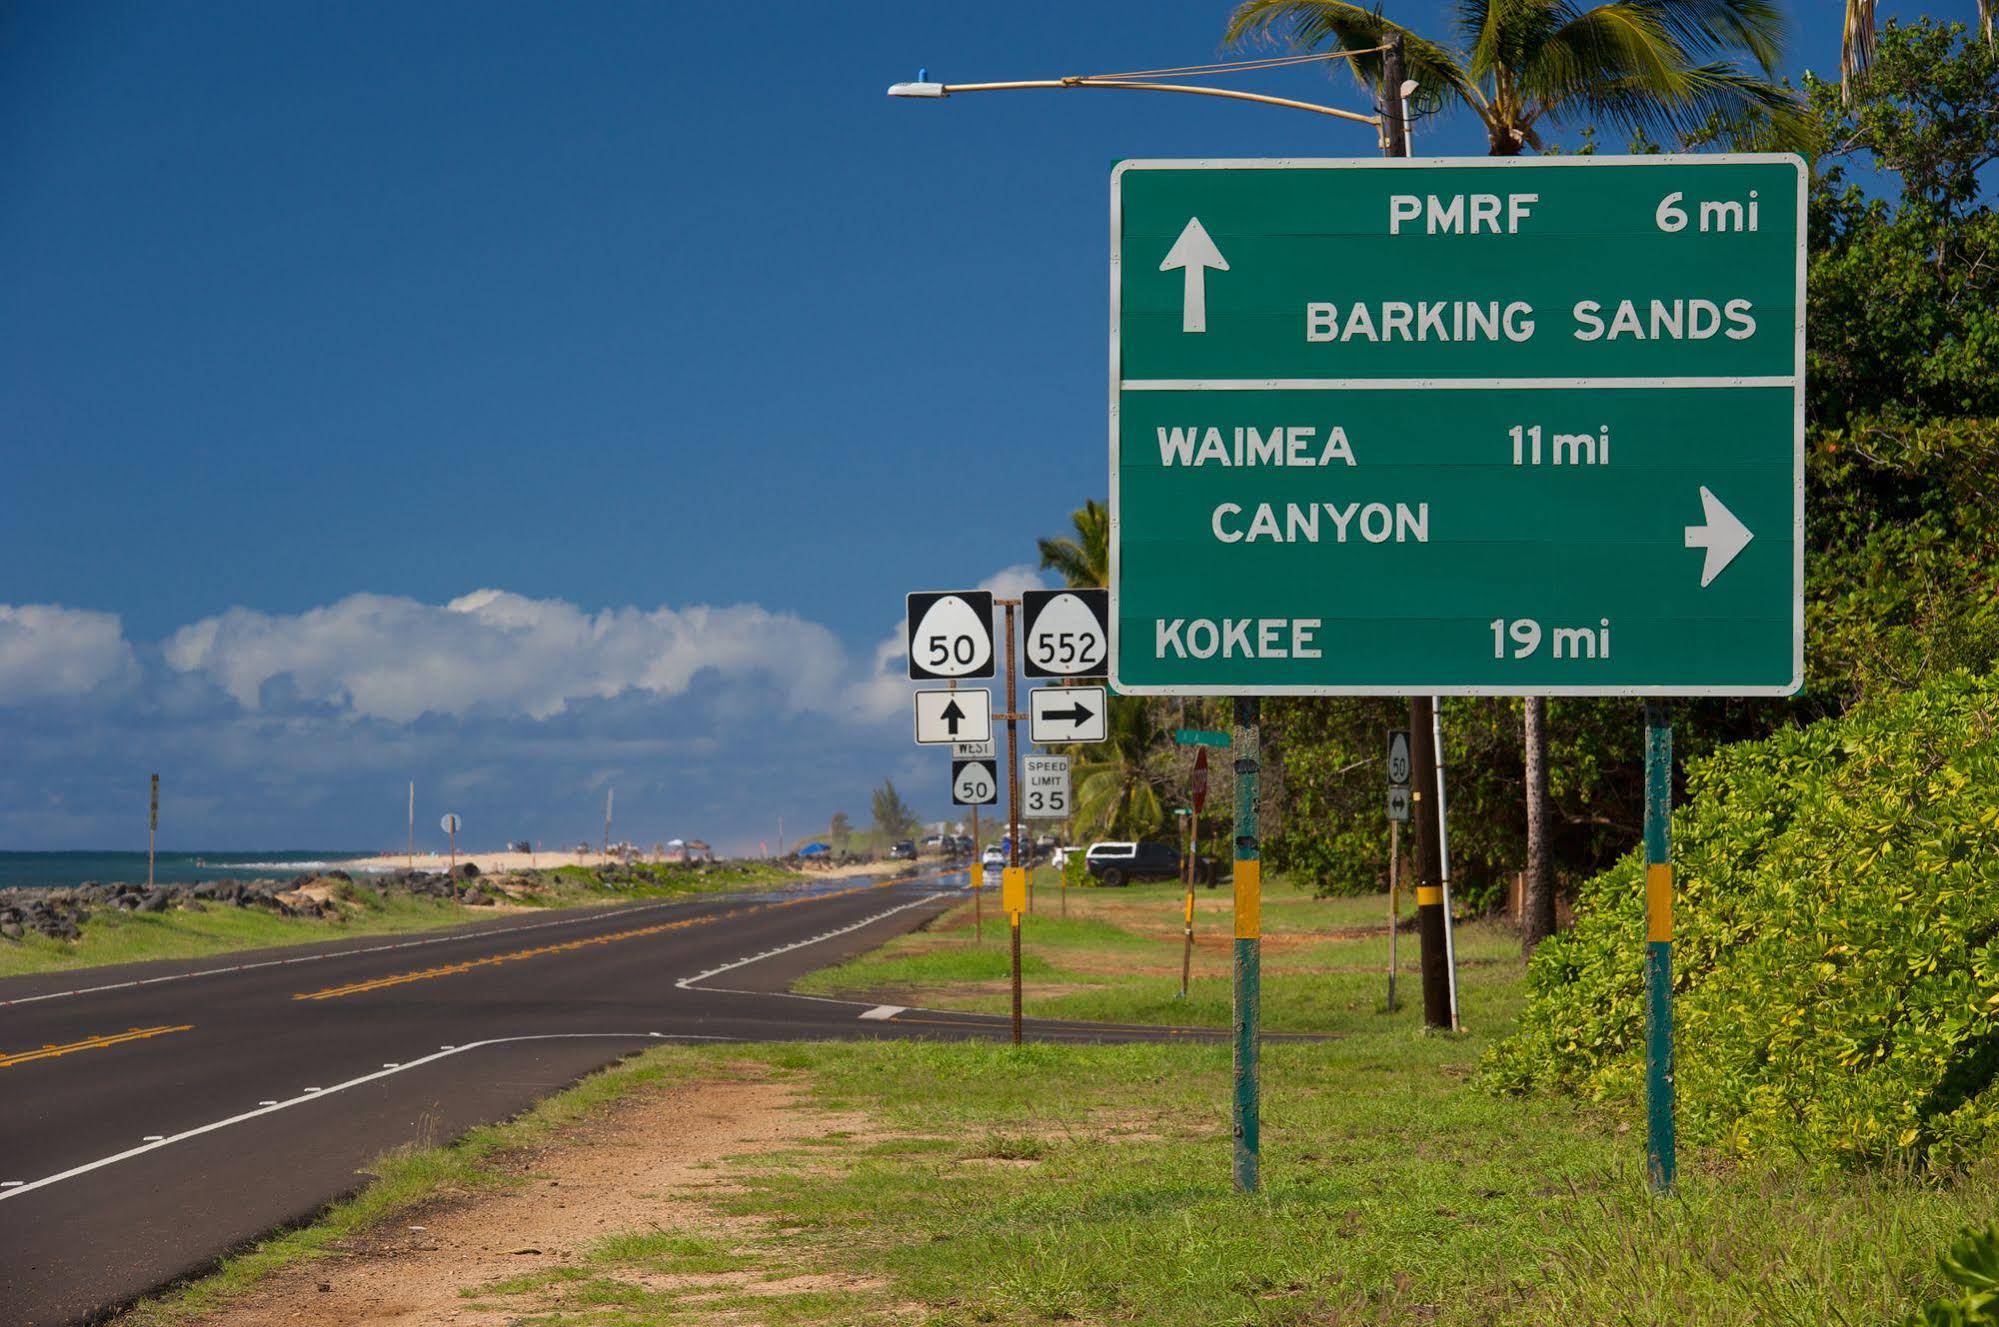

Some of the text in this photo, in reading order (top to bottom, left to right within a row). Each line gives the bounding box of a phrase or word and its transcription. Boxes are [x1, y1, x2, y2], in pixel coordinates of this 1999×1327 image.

[1390, 191, 1757, 234] PMRF 6 mi
[1307, 299, 1756, 342] BARKING SANDS
[1157, 425, 1608, 466] WAIMEA 11 mi
[1212, 503, 1428, 543] CANYON
[930, 635, 975, 665] 50
[1039, 633, 1096, 663] 552
[1156, 618, 1609, 658] KOKEE 19 mi
[1028, 762, 1067, 771] SPEED
[1032, 777, 1061, 785] LIMIT
[1393, 758, 1405, 777] 50
[963, 782, 987, 798] 50
[1030, 792, 1064, 810] 35
